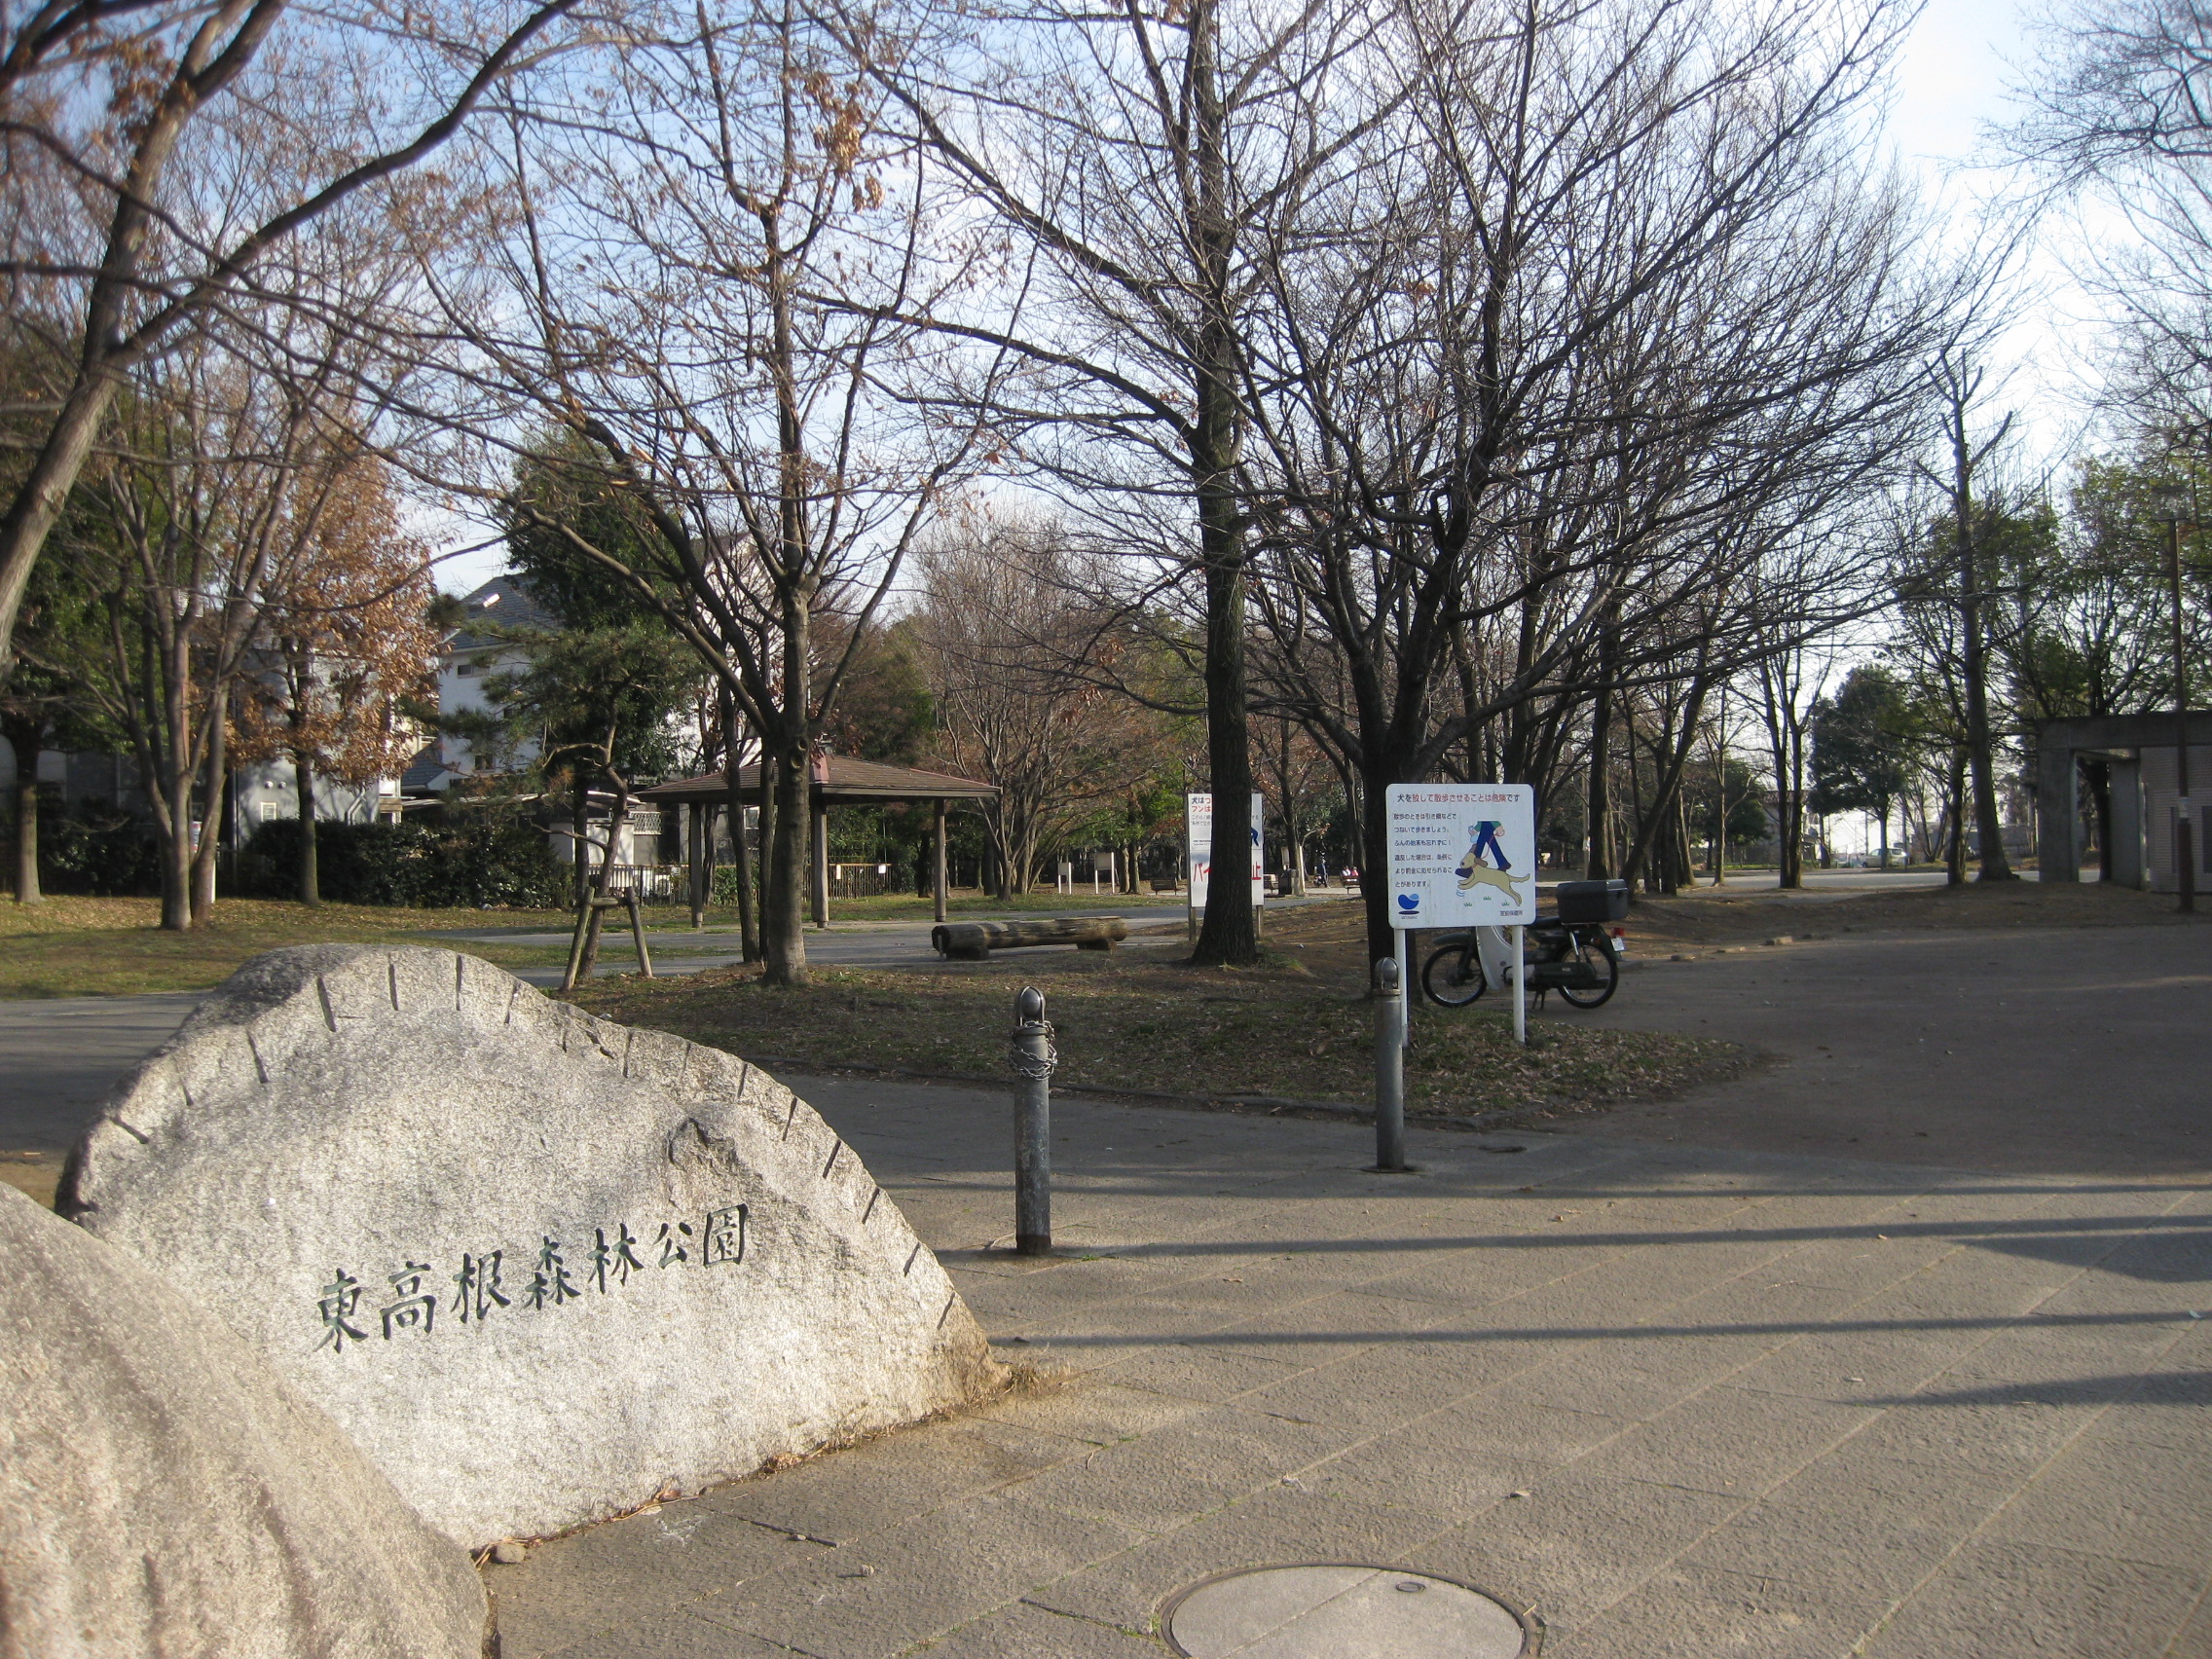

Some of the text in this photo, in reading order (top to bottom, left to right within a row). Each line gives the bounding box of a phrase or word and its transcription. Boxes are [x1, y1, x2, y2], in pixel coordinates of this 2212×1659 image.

[1396, 793, 1520, 802] 犬を放して散歩させることは危険です
[314, 1203, 747, 1354] 東高根森林公園
